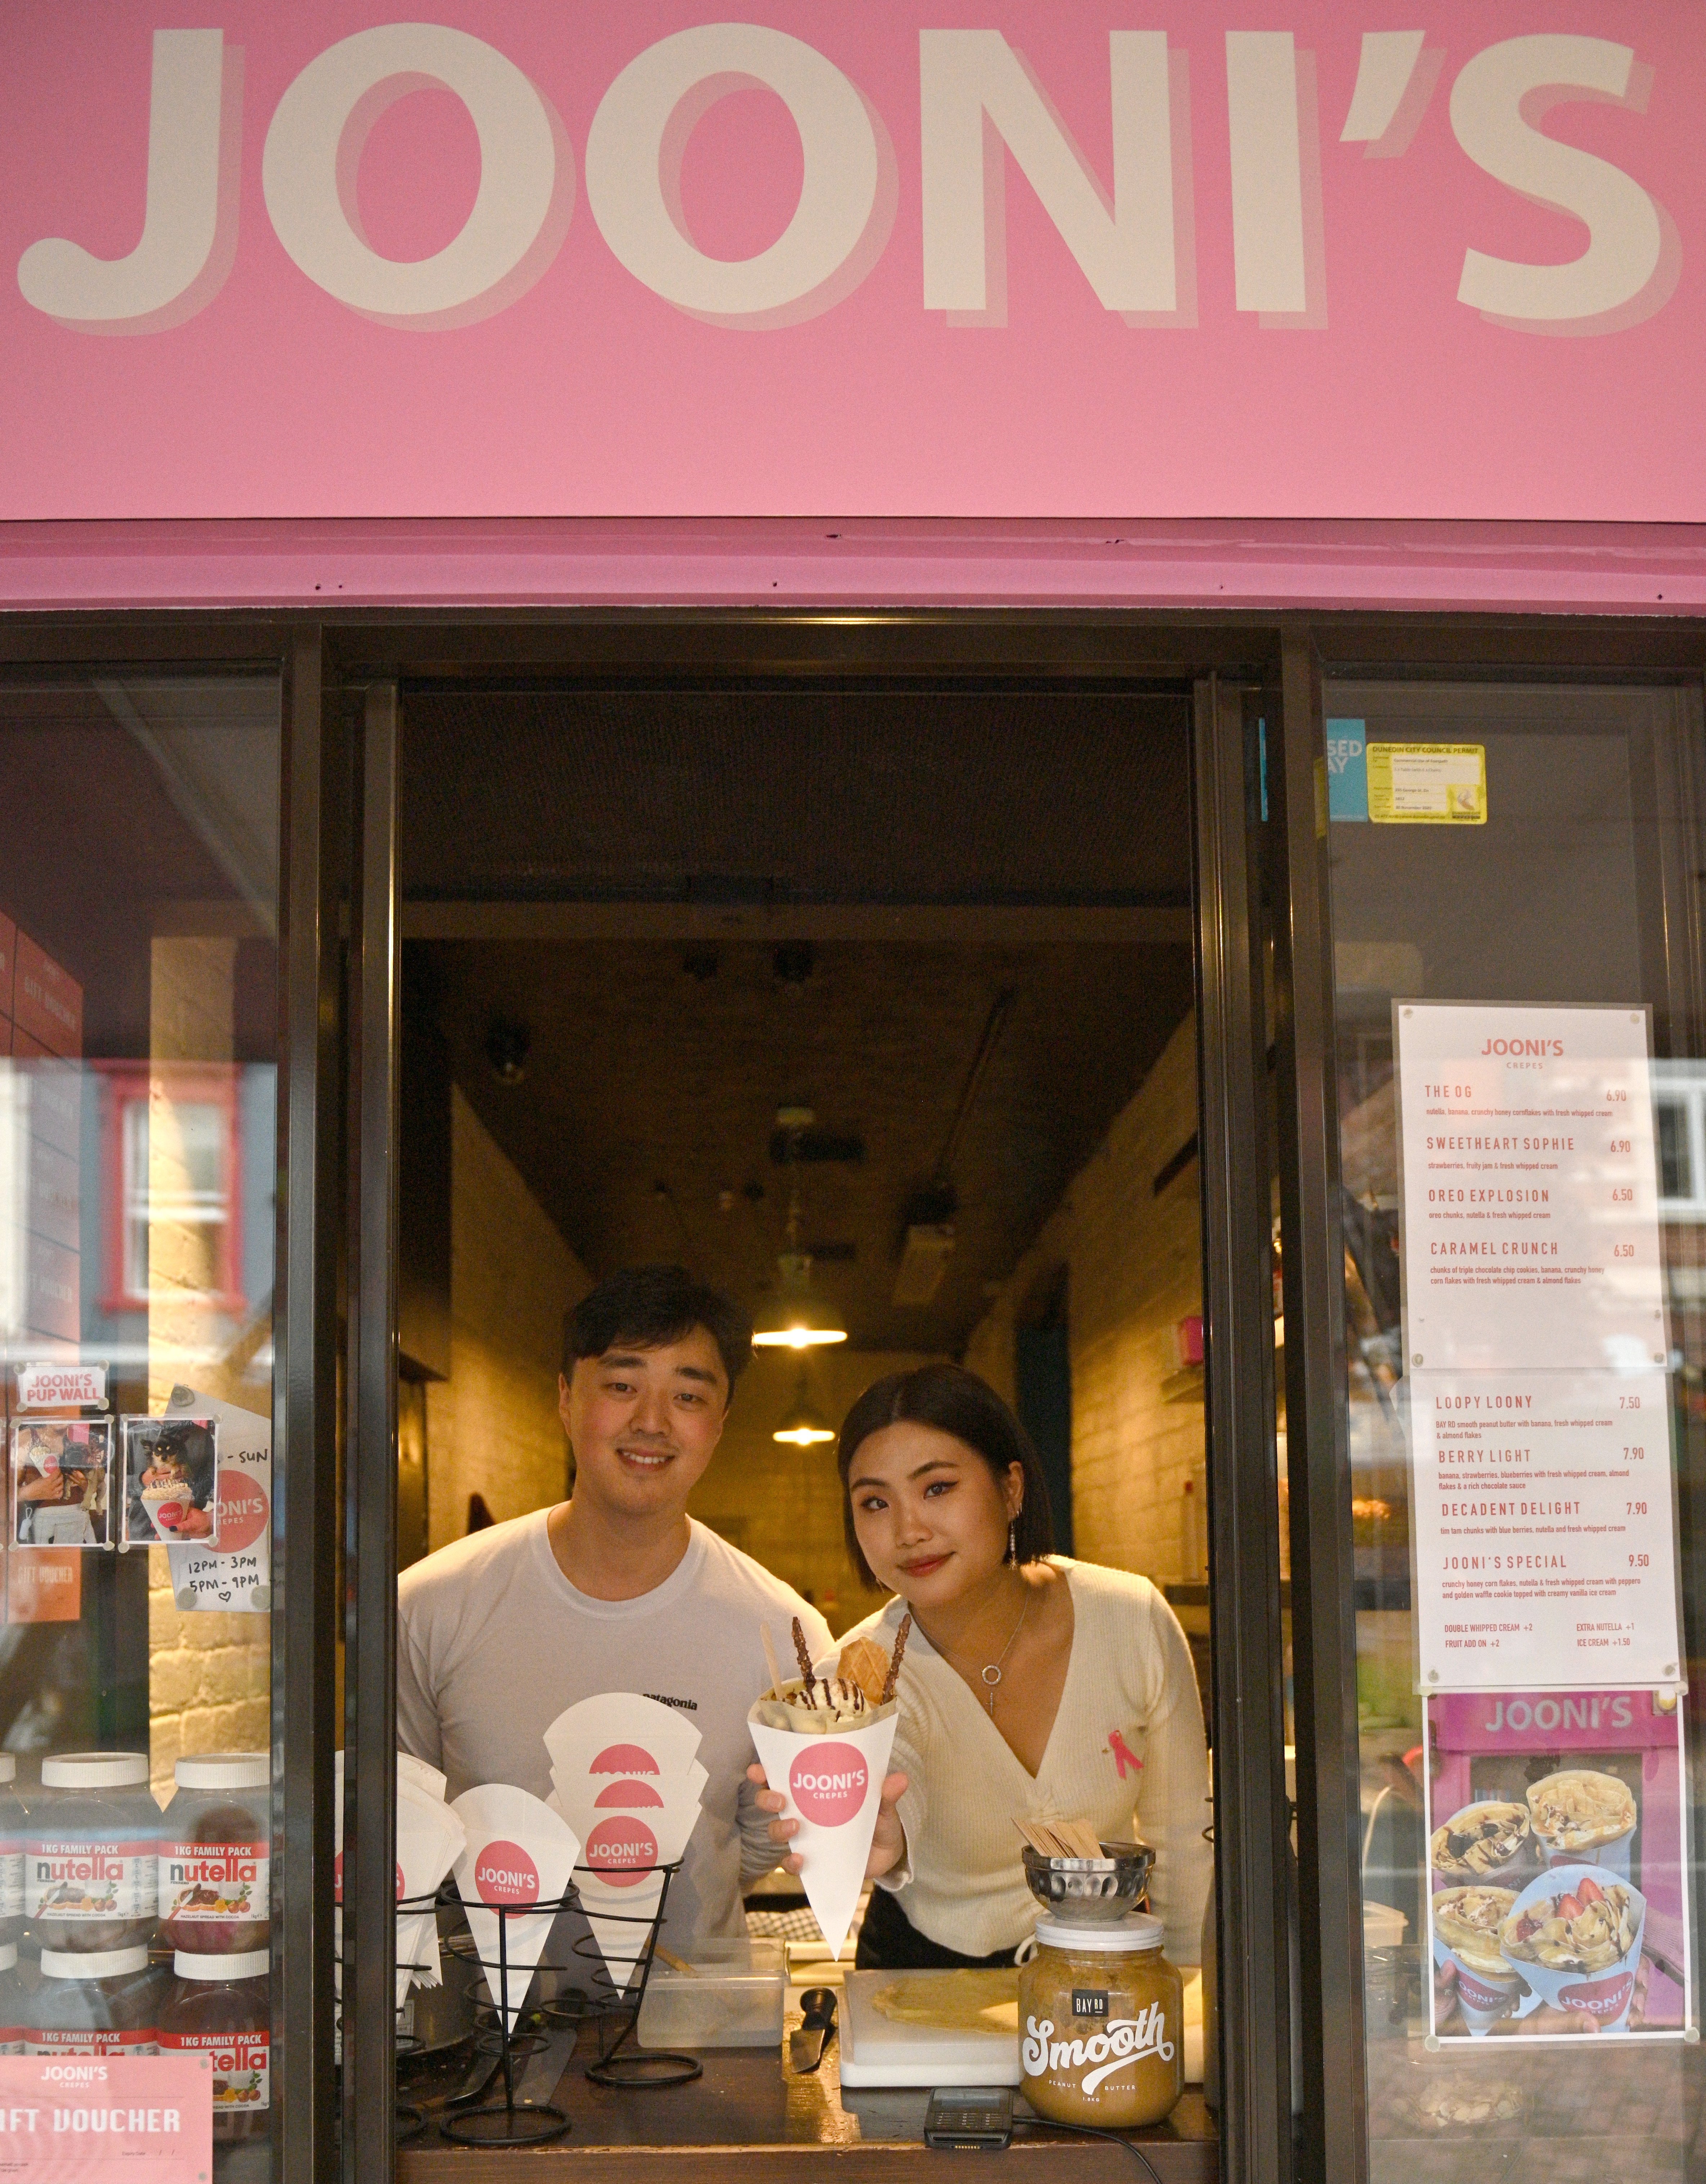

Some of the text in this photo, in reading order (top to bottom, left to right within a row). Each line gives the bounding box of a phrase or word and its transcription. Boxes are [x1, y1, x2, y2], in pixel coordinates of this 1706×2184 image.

[17, 21, 1664, 322] JOONI'S
[1481, 1039, 1563, 1056] JOONI'S
[1425, 1085, 1471, 1098] THE OG
[1606, 1090, 1626, 1101] 6.90
[1427, 1137, 1574, 1150] SWEETHEART SOPHIE
[1610, 1140, 1630, 1152] 6.90
[1429, 1189, 1548, 1202] OREO EXPLOSION
[1612, 1189, 1633, 1201] 6.50
[1508, 1211, 1531, 1220] whipped
[1431, 1242, 1557, 1255] CARAMEL CRUNCH
[1614, 1245, 1634, 1257] 6.50
[32, 1374, 92, 1387] JOONI'S
[27, 1388, 100, 1401] PUP WALL
[1436, 1395, 1531, 1409] LOOPY LOONY
[1620, 1397, 1640, 1409] 7.50
[1479, 1421, 1498, 1429] peanut
[1570, 1419, 1594, 1428] whipped
[239, 1448, 268, 1463] SUN
[1439, 1449, 1530, 1463] BERRY LIGHT
[1623, 1447, 1644, 1460] 7.90
[216, 1498, 263, 1517] ONI'S
[1442, 1502, 1580, 1516] DECADENT DELIGHT
[1626, 1502, 1647, 1515] 7.90
[1583, 1525, 1607, 1533] whipped
[189, 1560, 217, 1574] 12PM
[231, 1556, 256, 1568] 3PM
[1443, 1555, 1566, 1569] JOONI'S SPECIAL
[1629, 1554, 1649, 1567] 9.50
[189, 1579, 219, 1592] 5PM
[232, 1574, 259, 1588] 9PM
[1444, 1624, 1468, 1633] DOUBLE
[1485, 1696, 1633, 1732] JOONI'S
[793, 1769, 865, 1790] JOONI'S
[42, 1844, 119, 1854] 1KG FAMILY PACK
[175, 1846, 252, 1856] 1KG FAMILY PACK
[589, 1842, 653, 1857] JOONI'S
[37, 1857, 124, 1880] nutella
[170, 1858, 257, 1882] nutella
[478, 1867, 535, 1889] JOONI'S
[494, 1885, 520, 1895] CREPES
[1458, 1980, 1505, 2003] OONI'S
[1076, 1997, 1103, 2013] BAY RD
[42, 2032, 121, 2043] 1KG FAMILY PACK
[181, 2034, 262, 2046] 1KG FAMILY PACK
[1022, 2001, 1174, 2076] Smooth
[209, 2047, 267, 2072] tella
[41, 2065, 108, 2081] JOONI'S
[1049, 2079, 1076, 2089] PEANUT
[0, 2109, 180, 2132] IFT VOUCHER
